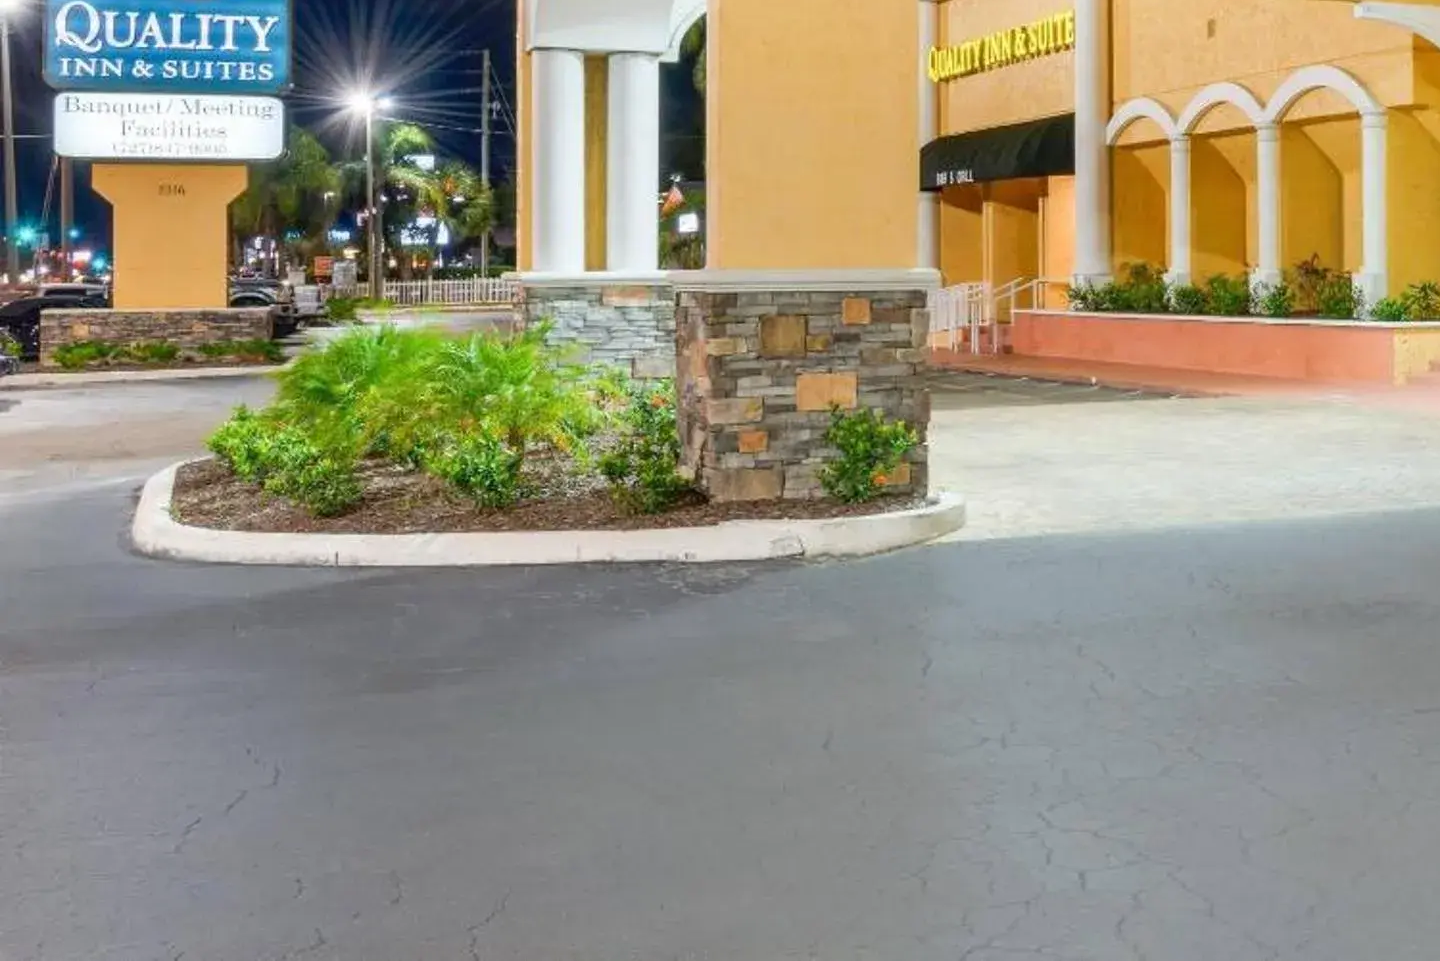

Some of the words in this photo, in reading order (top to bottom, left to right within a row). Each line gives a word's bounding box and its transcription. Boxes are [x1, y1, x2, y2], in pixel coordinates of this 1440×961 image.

[54, 0, 280, 53] QUALITY
[928, 39, 982, 82] QUALITY
[984, 29, 1012, 64] INN
[1014, 30, 1027, 56] &
[1028, 10, 1074, 51] SUITE
[59, 57, 124, 78] INN
[131, 60, 155, 79] &
[162, 60, 275, 81] SUITES
[120, 119, 229, 139] Facilities
